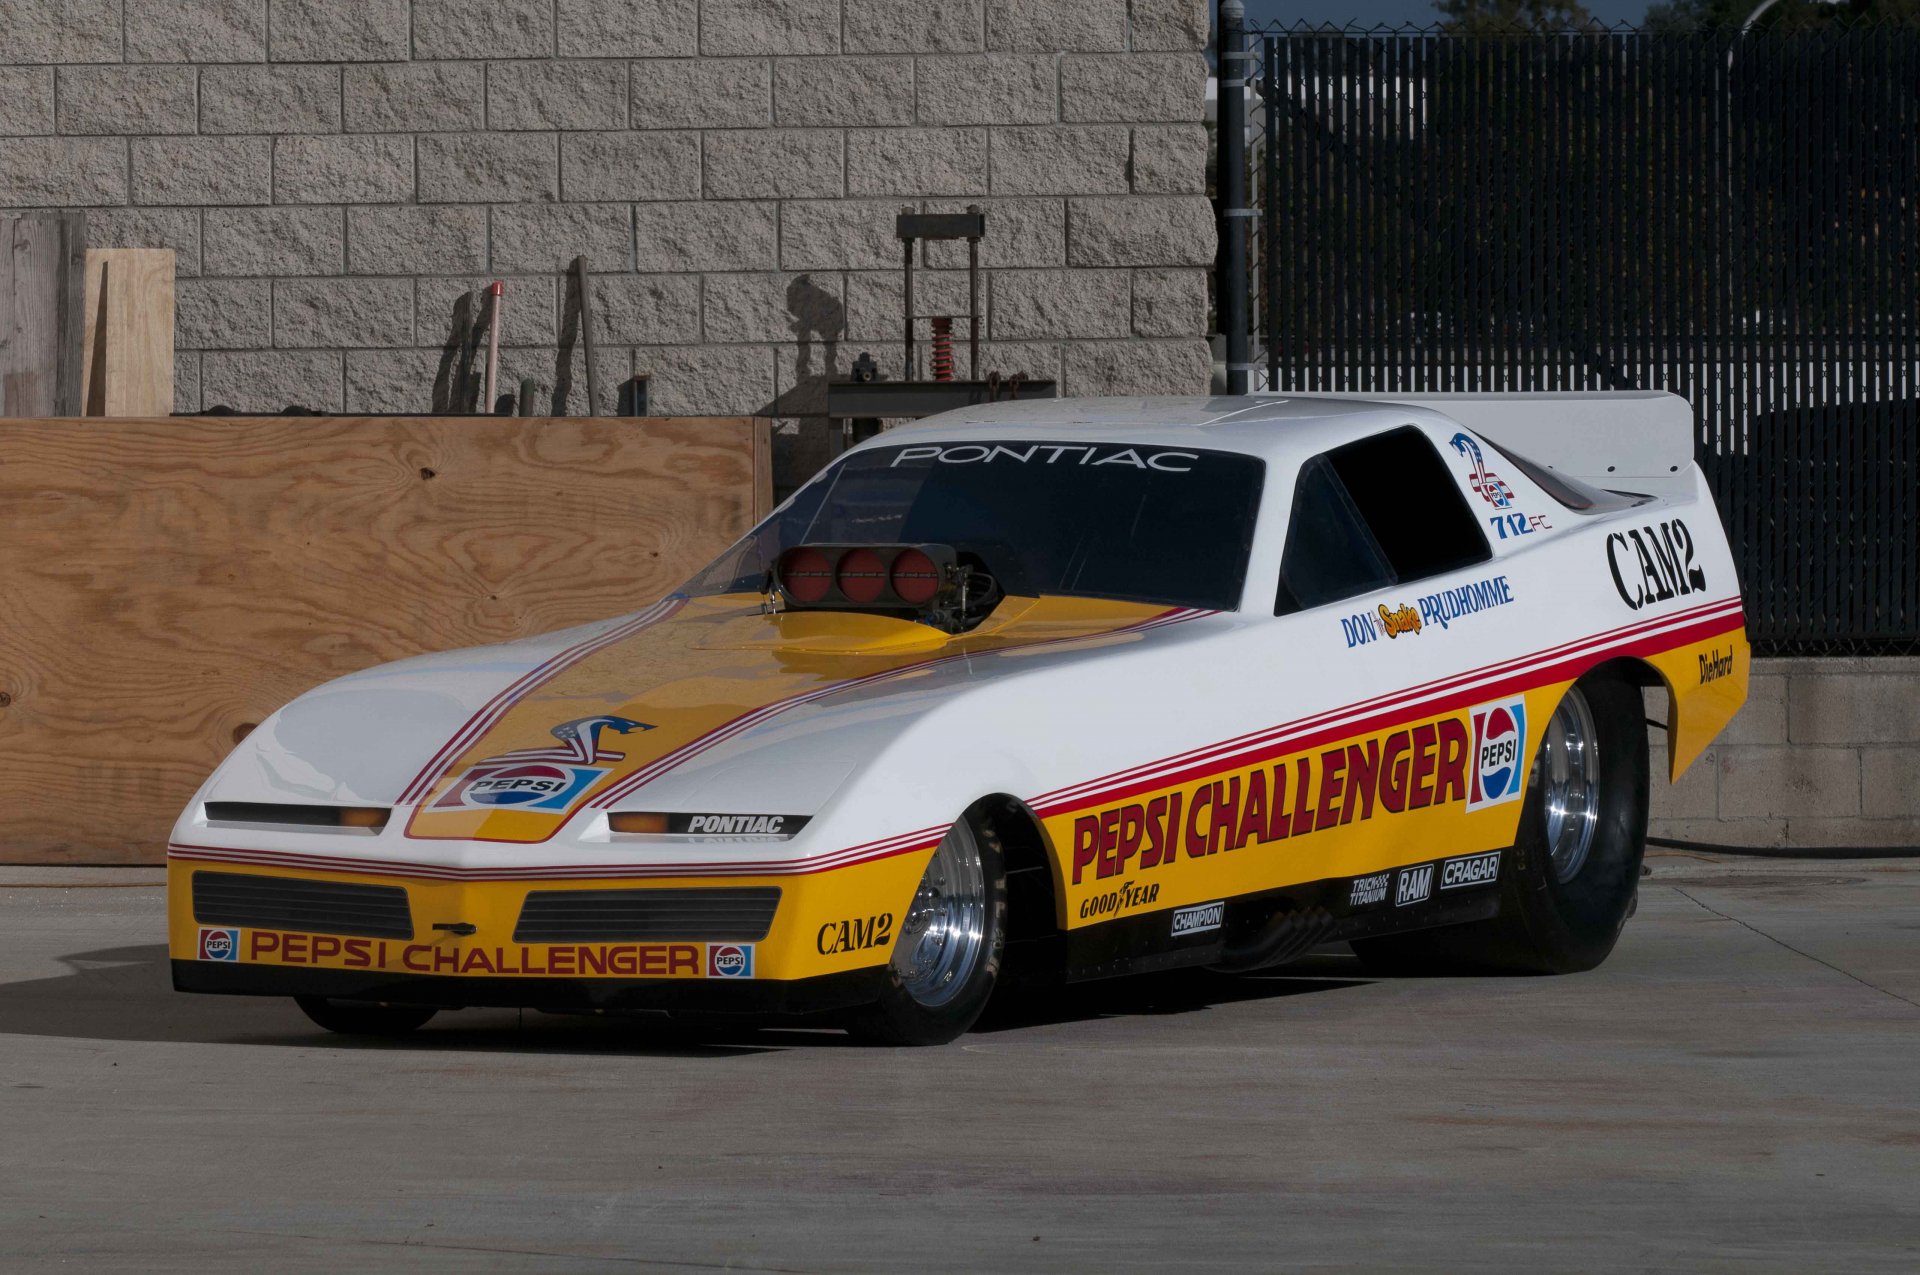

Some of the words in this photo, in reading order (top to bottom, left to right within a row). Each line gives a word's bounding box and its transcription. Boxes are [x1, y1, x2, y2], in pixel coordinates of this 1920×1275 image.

[891, 445, 1198, 472] PONTIAC
[1606, 518, 1706, 610] CAM2
[1340, 612, 1377, 648] DON
[1378, 603, 1422, 639] Snake
[1417, 576, 1514, 629] PRUDHOMME
[1698, 645, 1733, 684] DieHard
[1480, 738, 1516, 769] PEPSI
[472, 778, 567, 792] PEPSI
[1072, 792, 1182, 885] PEPSI
[1185, 718, 1468, 857] CHALLENGER
[688, 815, 785, 833] PONTIAC
[1353, 876, 1377, 892] TRICK
[1444, 856, 1498, 884] CRAGAR
[1350, 888, 1387, 905] TITANIUM
[1398, 867, 1432, 902] RAM
[1174, 906, 1222, 930] CHAMPION
[206, 940, 231, 950] PEPSI
[817, 913, 893, 955] CAM2
[251, 931, 386, 968] PEPSI
[402, 944, 700, 975] CHALLENGER
[716, 956, 744, 966] PEPSI
